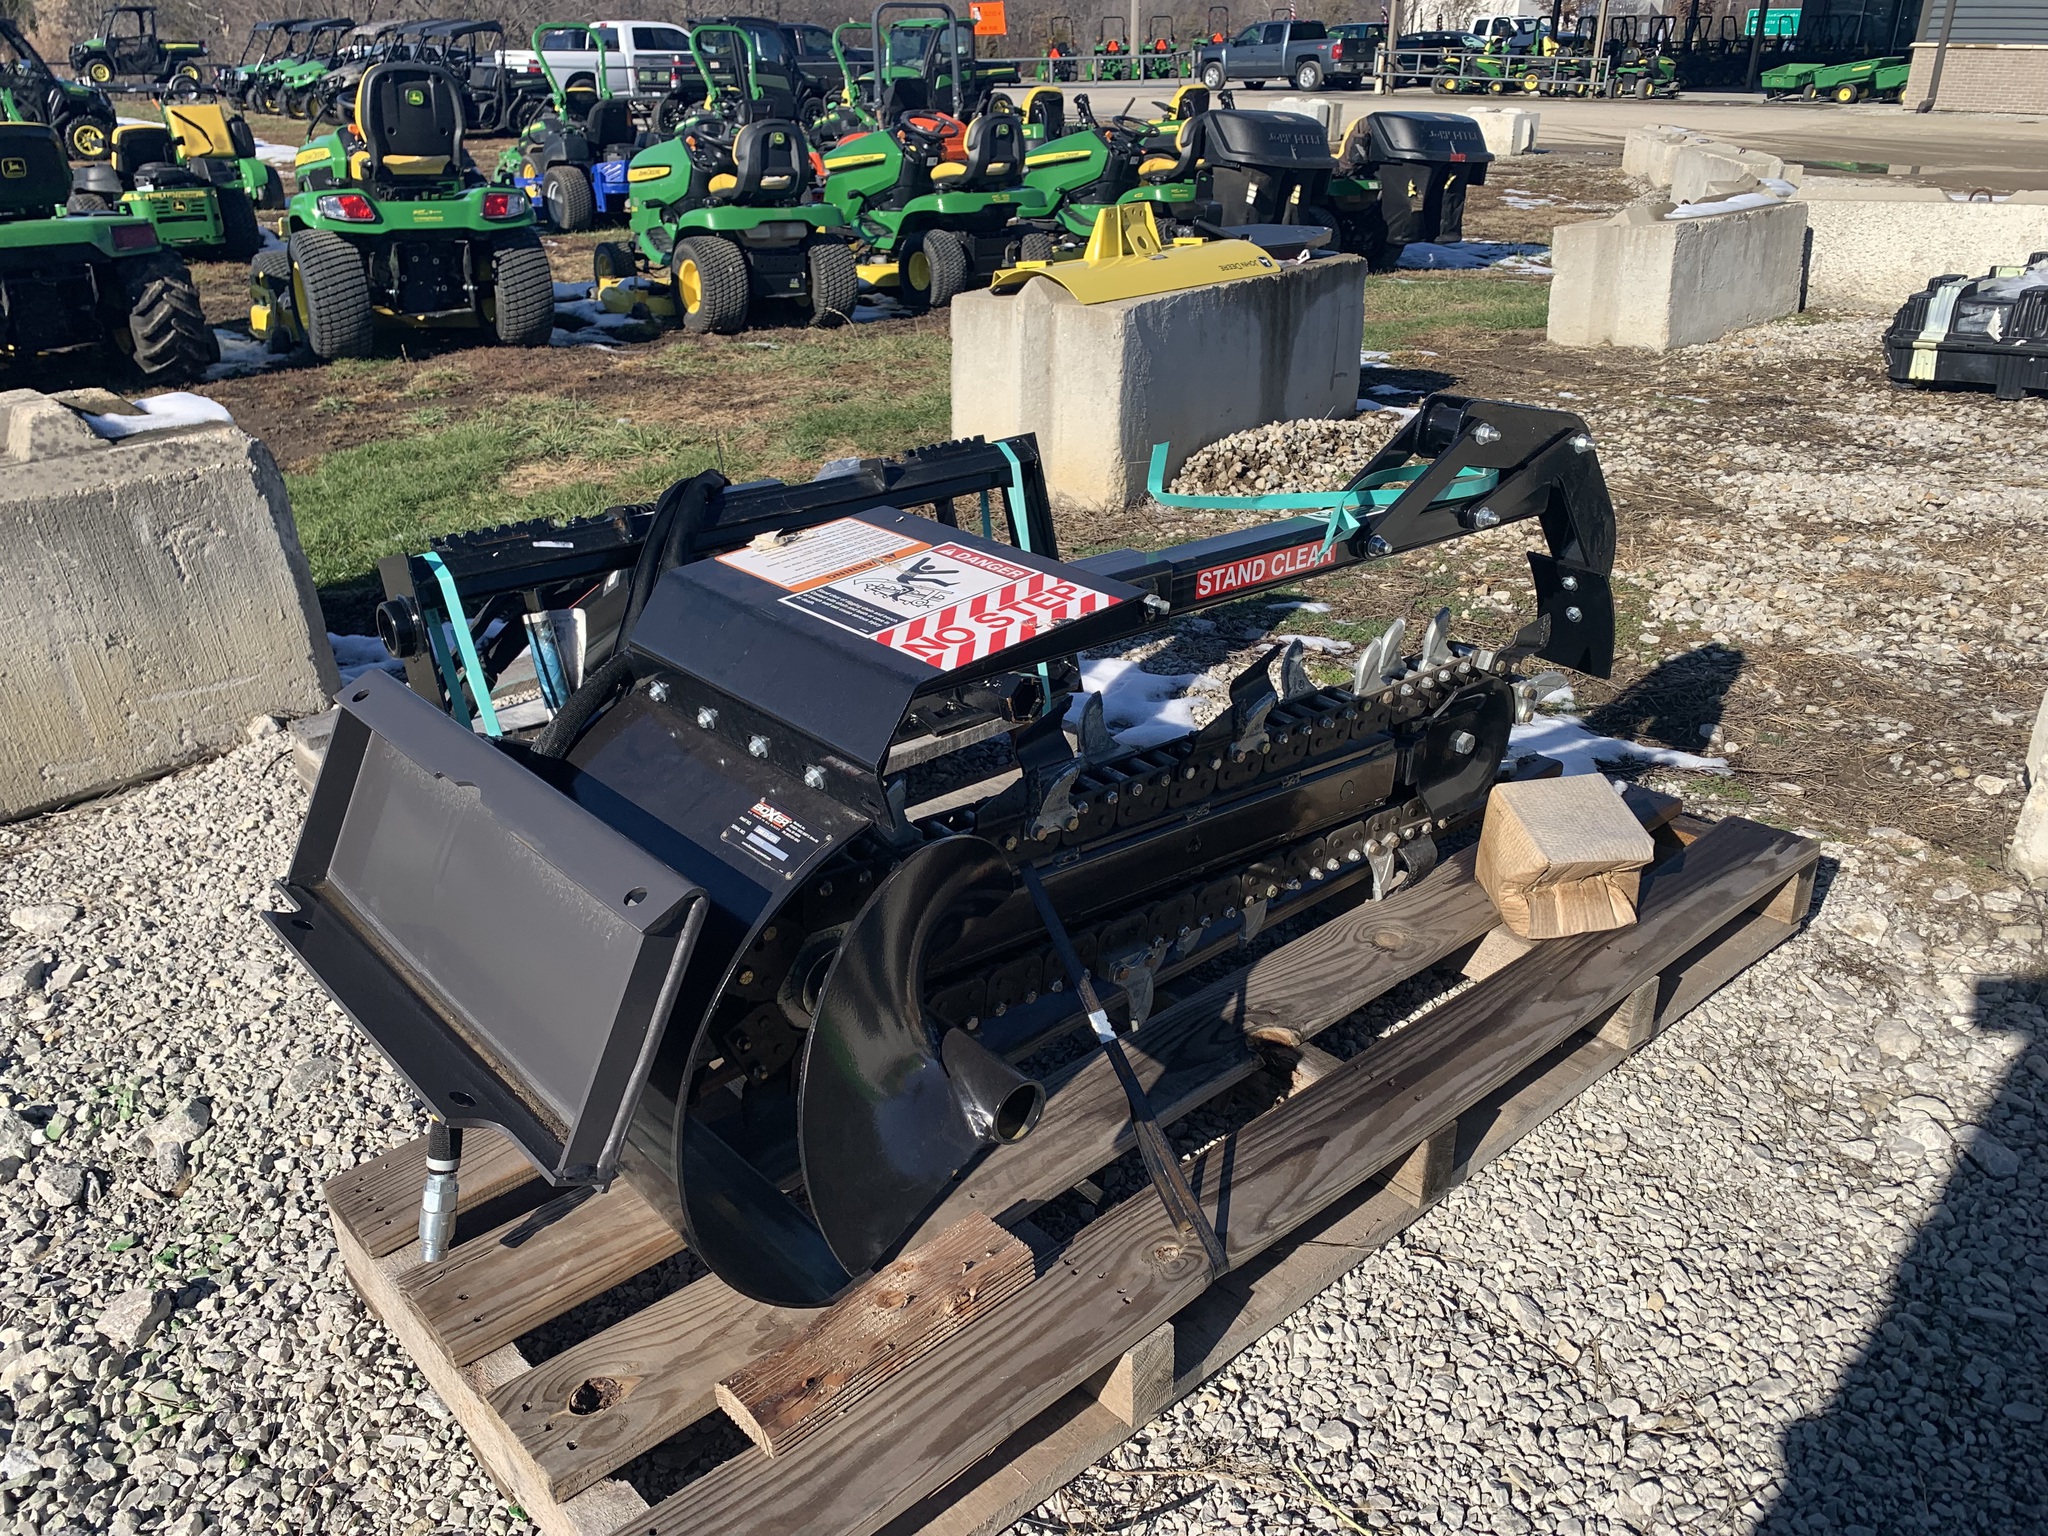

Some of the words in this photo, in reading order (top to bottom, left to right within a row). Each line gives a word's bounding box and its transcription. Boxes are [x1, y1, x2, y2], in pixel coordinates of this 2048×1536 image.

[1218, 262, 1243, 271] DEERE
[1241, 260, 1259, 269] JOHN
[954, 549, 1026, 580] DANGER
[1198, 558, 1266, 596] STAND
[1271, 545, 1333, 577] CLEAR
[900, 627, 976, 657] NO
[973, 584, 1078, 629] STEP
[752, 803, 790, 828] BOXER
